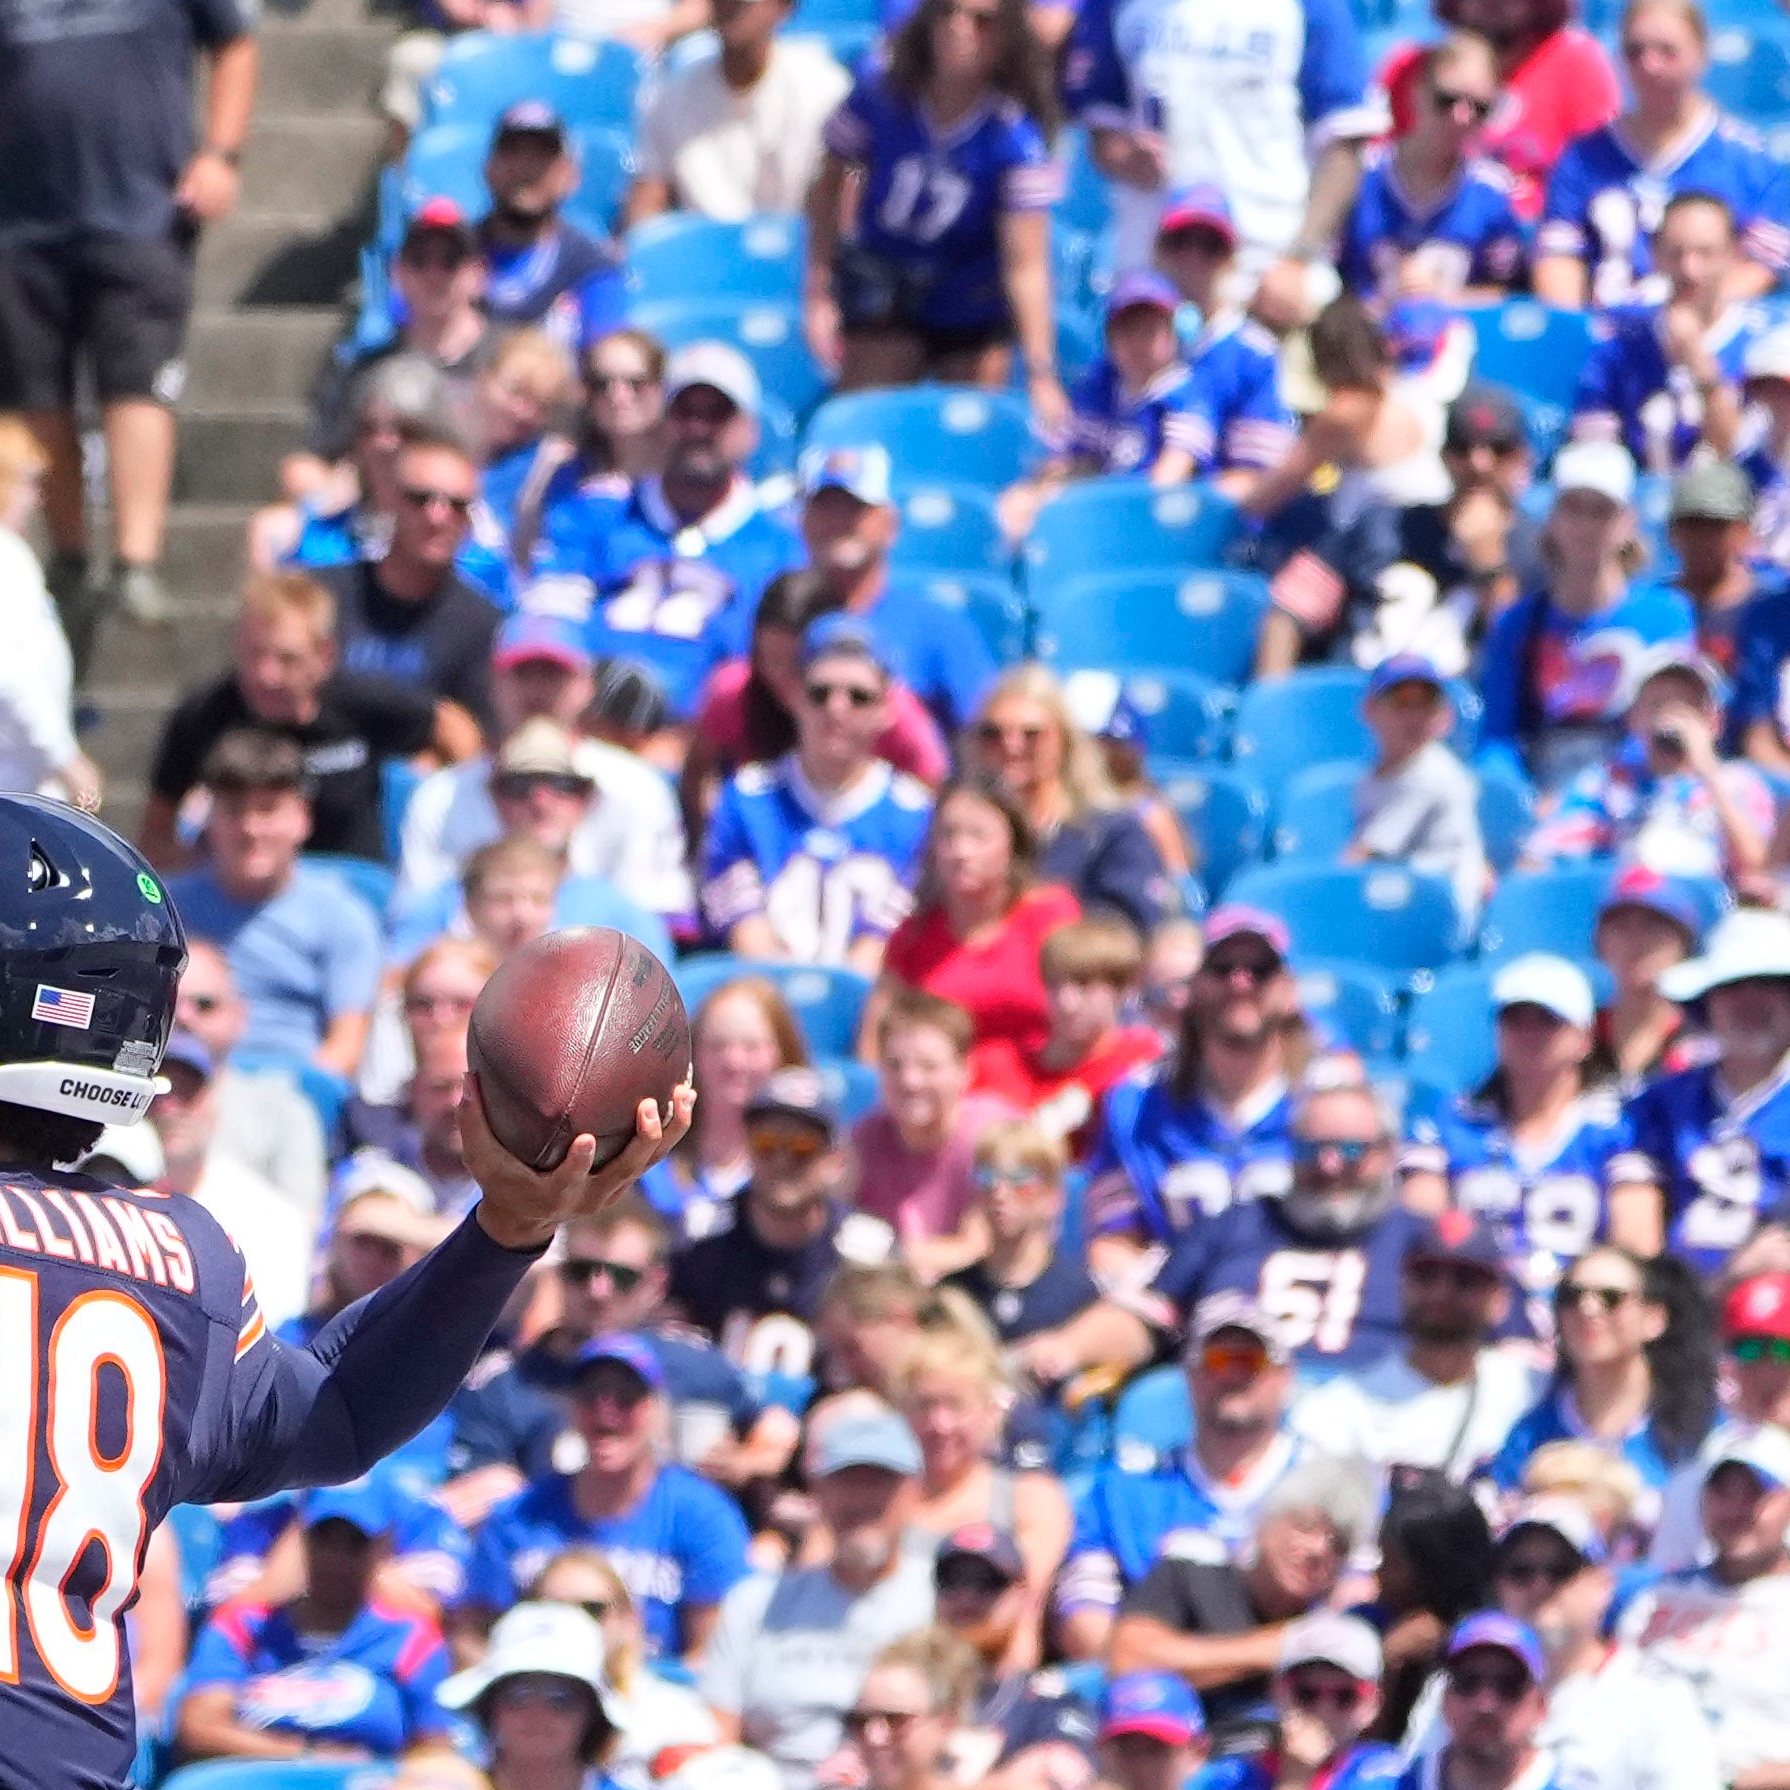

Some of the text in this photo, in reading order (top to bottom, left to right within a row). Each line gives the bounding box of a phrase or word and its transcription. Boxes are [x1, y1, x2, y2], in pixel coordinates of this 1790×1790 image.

[877, 155, 974, 245] 17
[627, 1012, 658, 1054] LEAGUE
[60, 1078, 132, 1108] CHOOSE
[1261, 1250, 1365, 1355] 51
